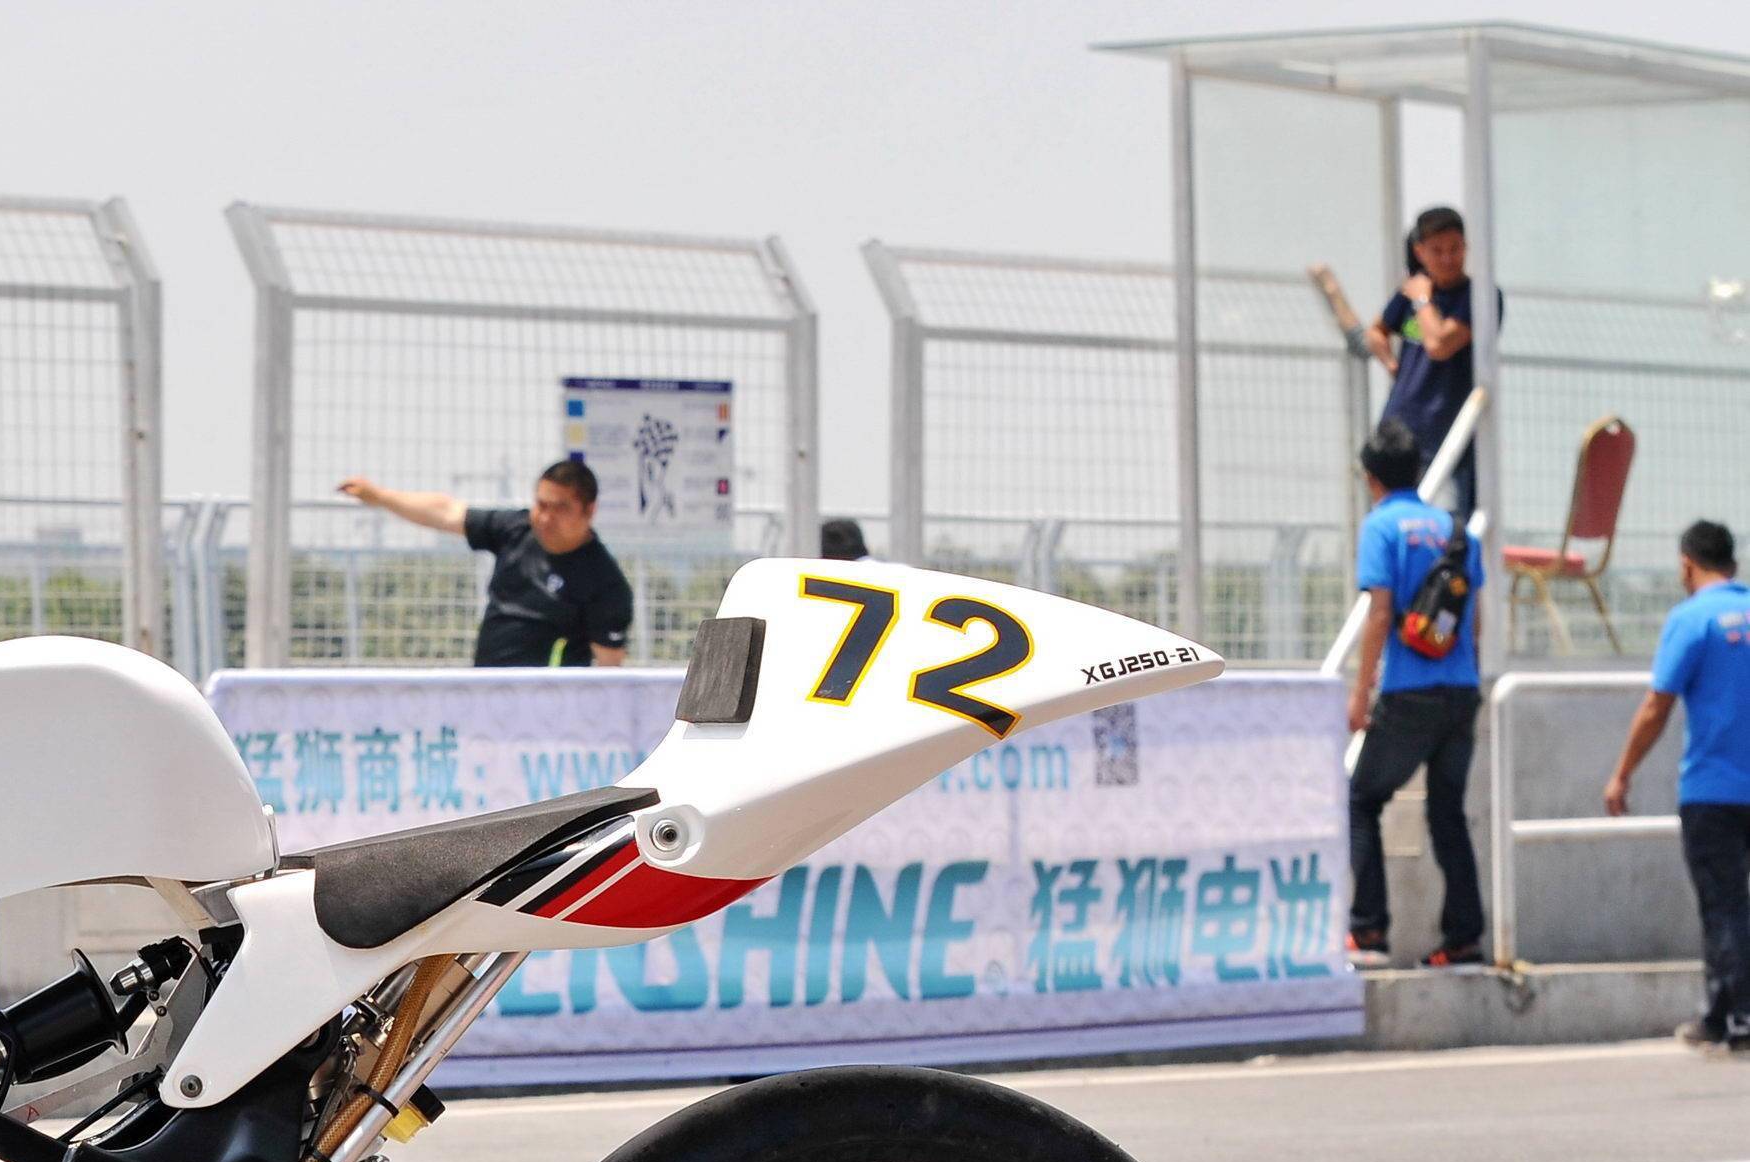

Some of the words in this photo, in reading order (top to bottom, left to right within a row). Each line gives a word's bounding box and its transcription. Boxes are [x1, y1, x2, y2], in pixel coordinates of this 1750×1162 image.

[798, 573, 1035, 740] 72
[1080, 646, 1201, 685] XGJ250-21
[1029, 851, 1334, 991] 猛狮电池
